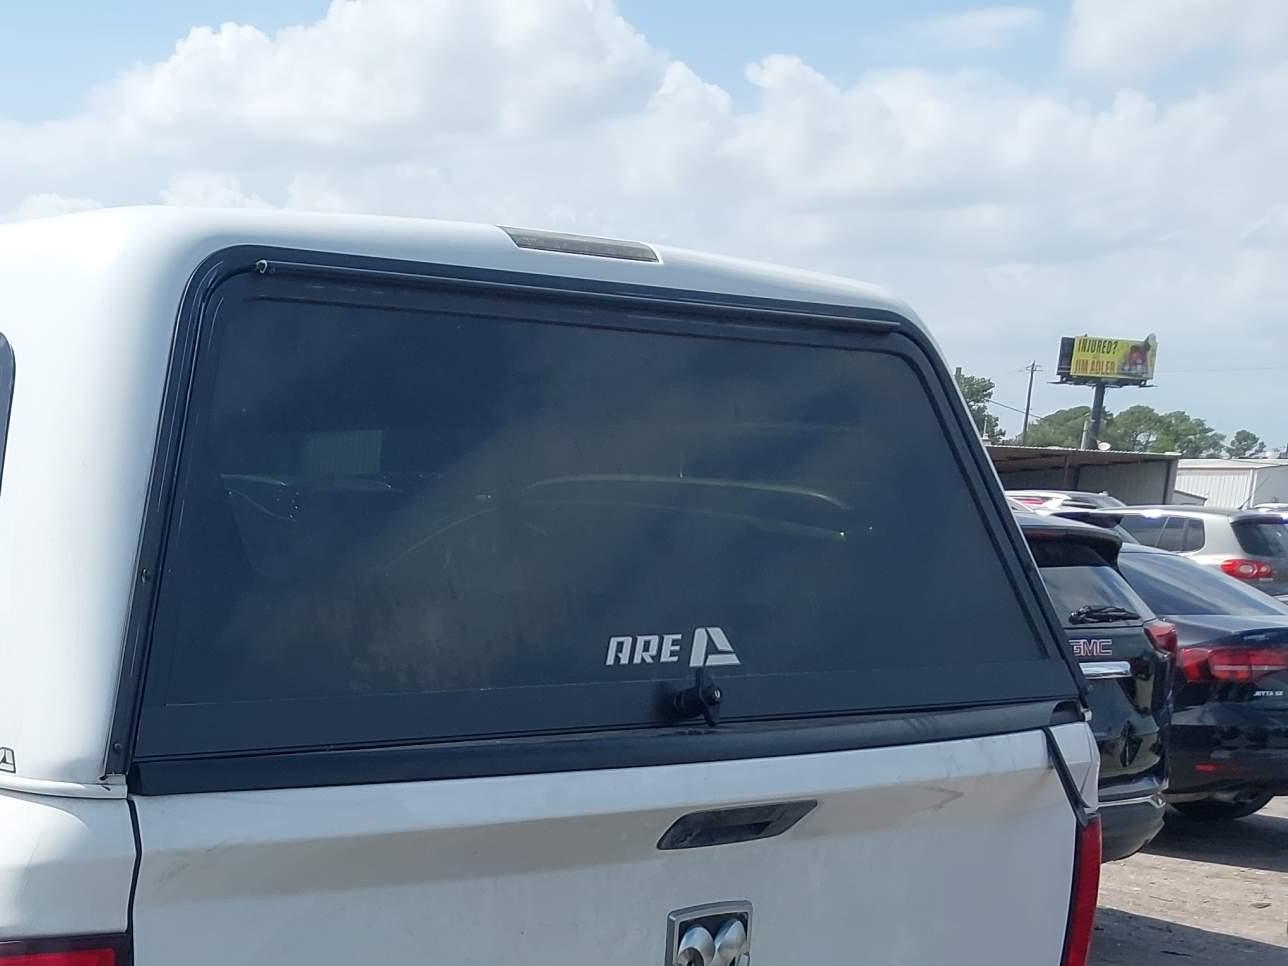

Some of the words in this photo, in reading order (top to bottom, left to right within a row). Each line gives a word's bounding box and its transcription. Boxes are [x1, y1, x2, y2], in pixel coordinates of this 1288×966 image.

[1078, 338, 1119, 354] INJURED?
[605, 634, 682, 665] ARE
[1068, 639, 1112, 656] GMC
